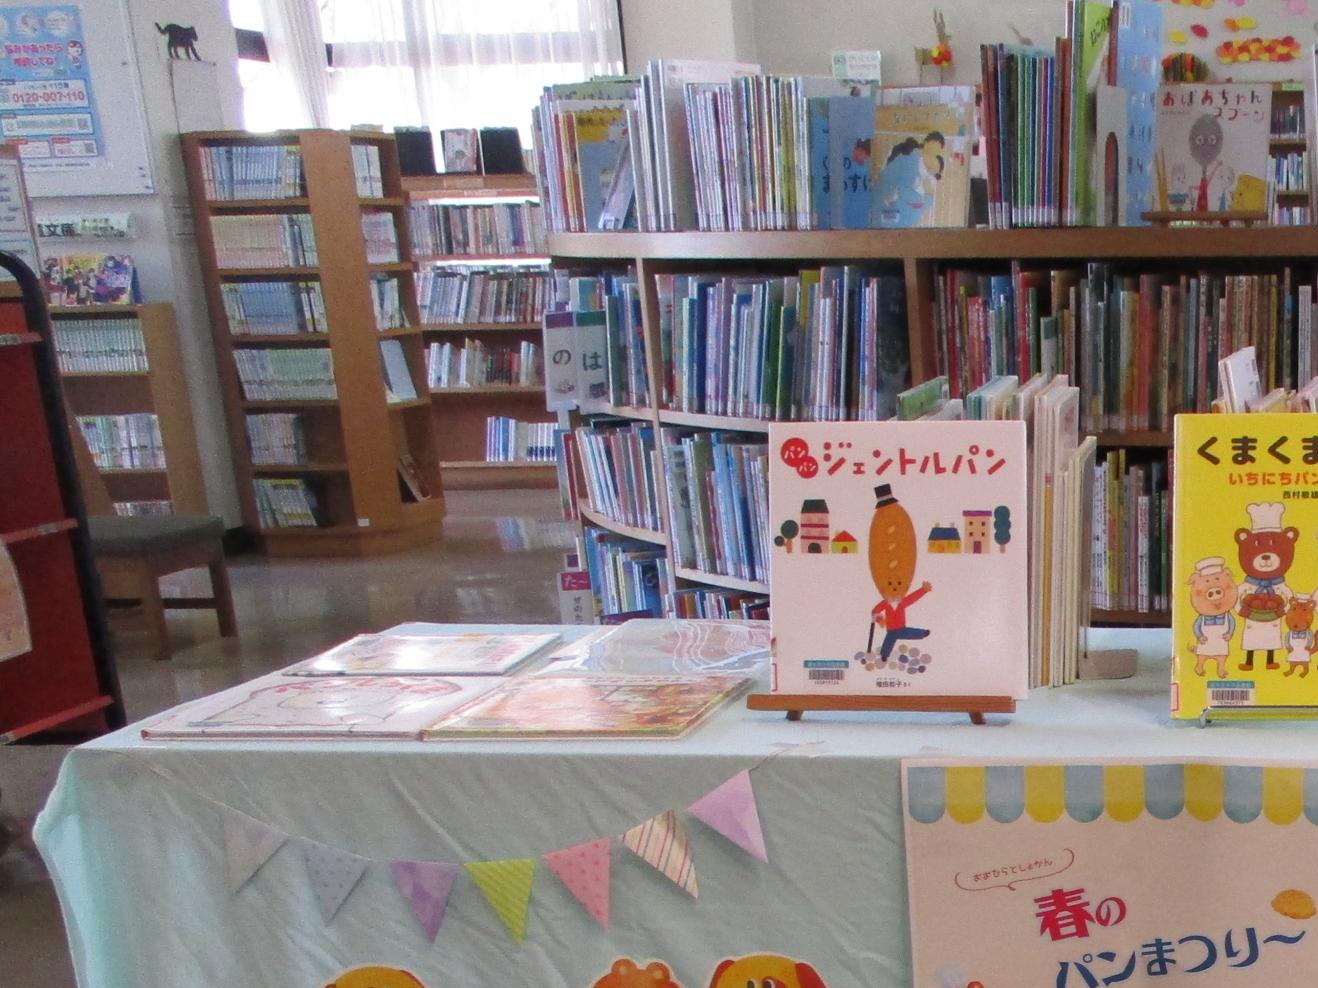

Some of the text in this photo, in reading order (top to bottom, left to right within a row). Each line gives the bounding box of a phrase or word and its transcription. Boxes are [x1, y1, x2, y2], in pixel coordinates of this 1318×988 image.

[552, 349, 572, 366] の
[582, 351, 603, 372] は
[823, 441, 1007, 476] ジェントルパン
[1033, 887, 1128, 943] 春の
